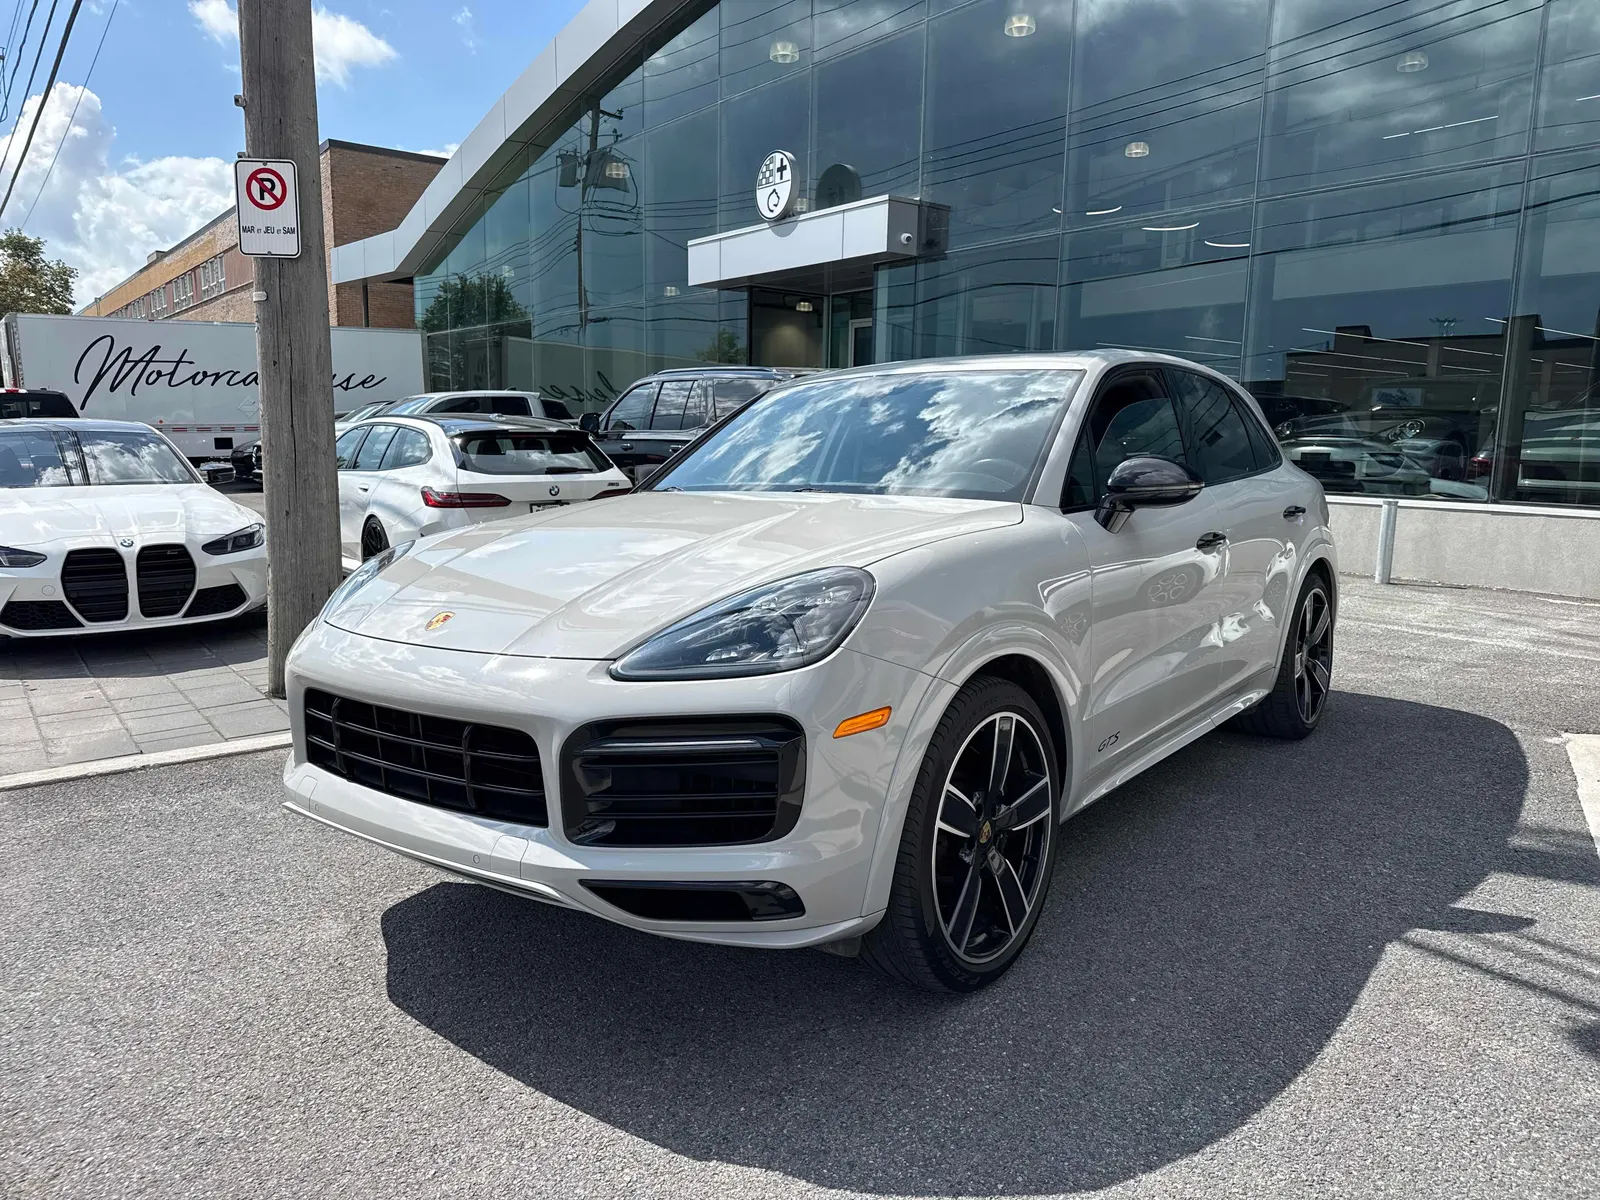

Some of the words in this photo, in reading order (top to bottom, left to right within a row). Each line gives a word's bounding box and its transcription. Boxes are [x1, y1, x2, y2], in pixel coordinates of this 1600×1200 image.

[242, 225, 255, 233] MAR
[264, 226, 274, 234] JEU
[282, 226, 295, 234] SAM
[1097, 731, 1121, 752] GTS
